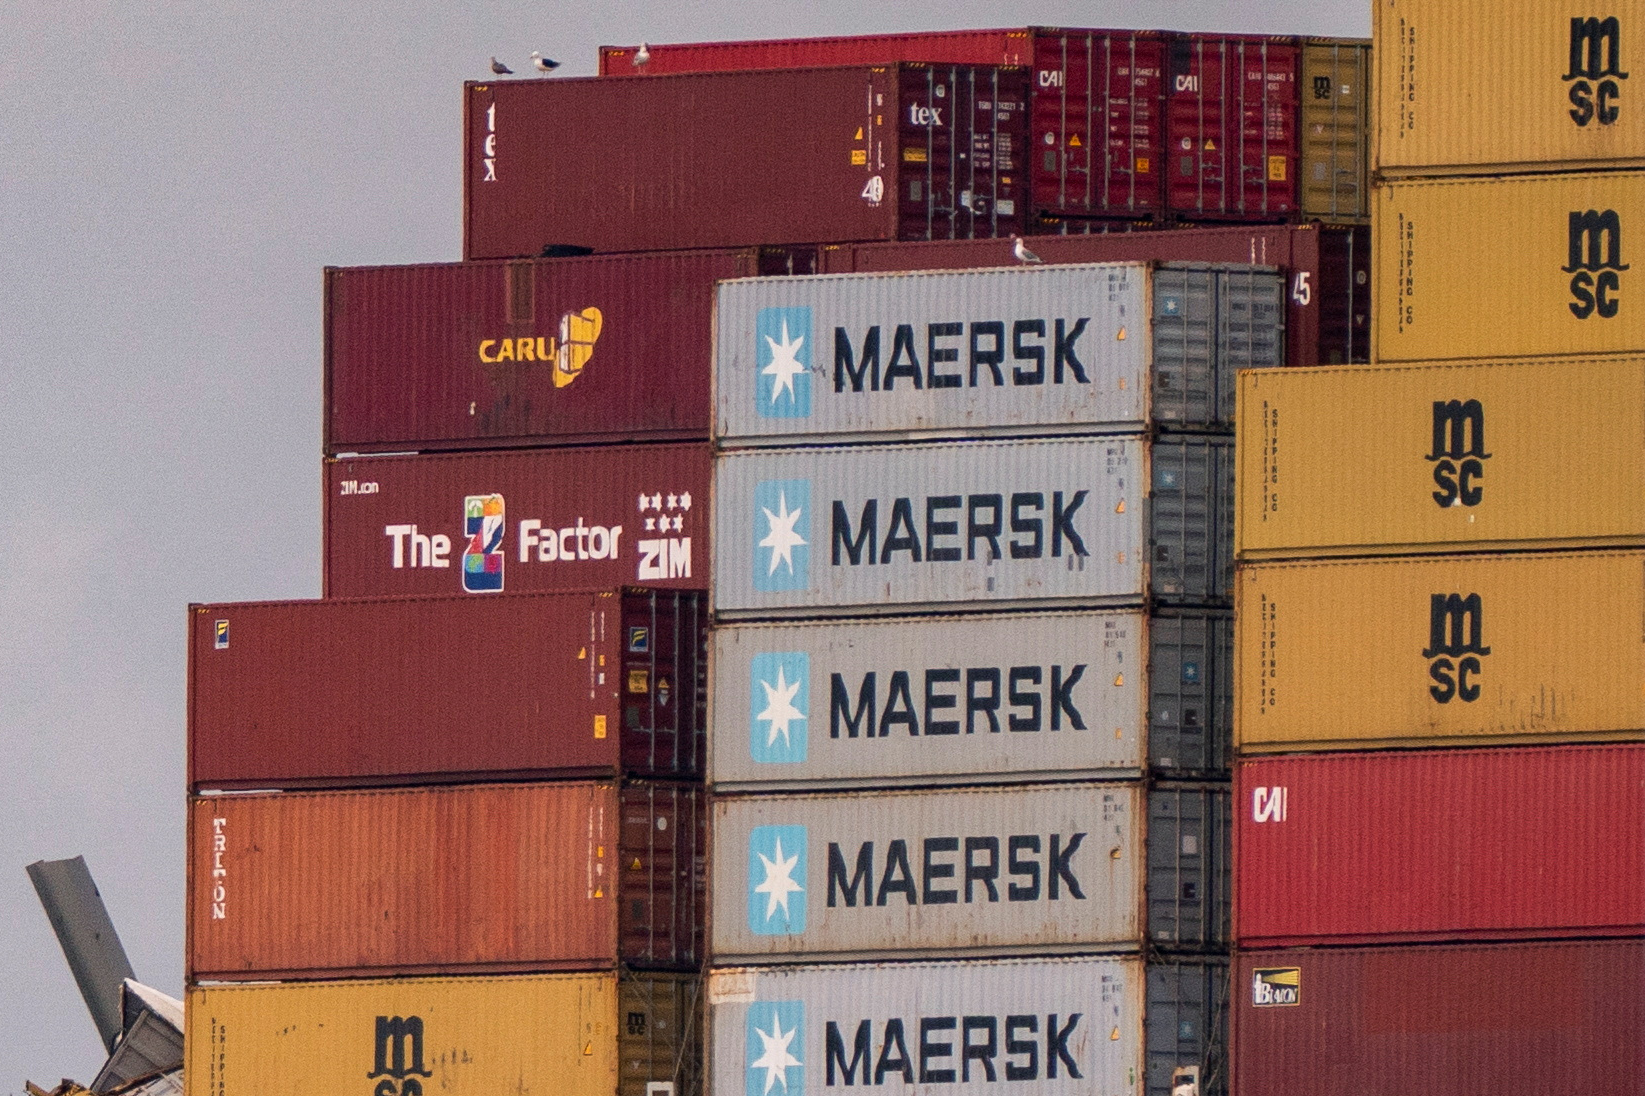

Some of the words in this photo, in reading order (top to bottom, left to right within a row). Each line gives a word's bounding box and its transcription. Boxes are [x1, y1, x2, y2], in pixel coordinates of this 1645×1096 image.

[1040, 70, 1063, 87] CAI
[1175, 75, 1198, 92] CAI
[910, 102, 943, 126] tex
[483, 101, 497, 182] tex
[1293, 271, 1311, 306] 45
[478, 337, 556, 364] CARU
[834, 317, 1092, 394] MAERSK
[385, 524, 451, 569] The
[519, 517, 623, 563] Factor
[831, 489, 1091, 566] MAERSK
[638, 537, 692, 581] ZIM
[830, 664, 1088, 739] MAERSK
[1253, 786, 1287, 822] CAI
[827, 832, 1088, 909] MAERSK
[825, 1012, 1083, 1087] MAERSK
